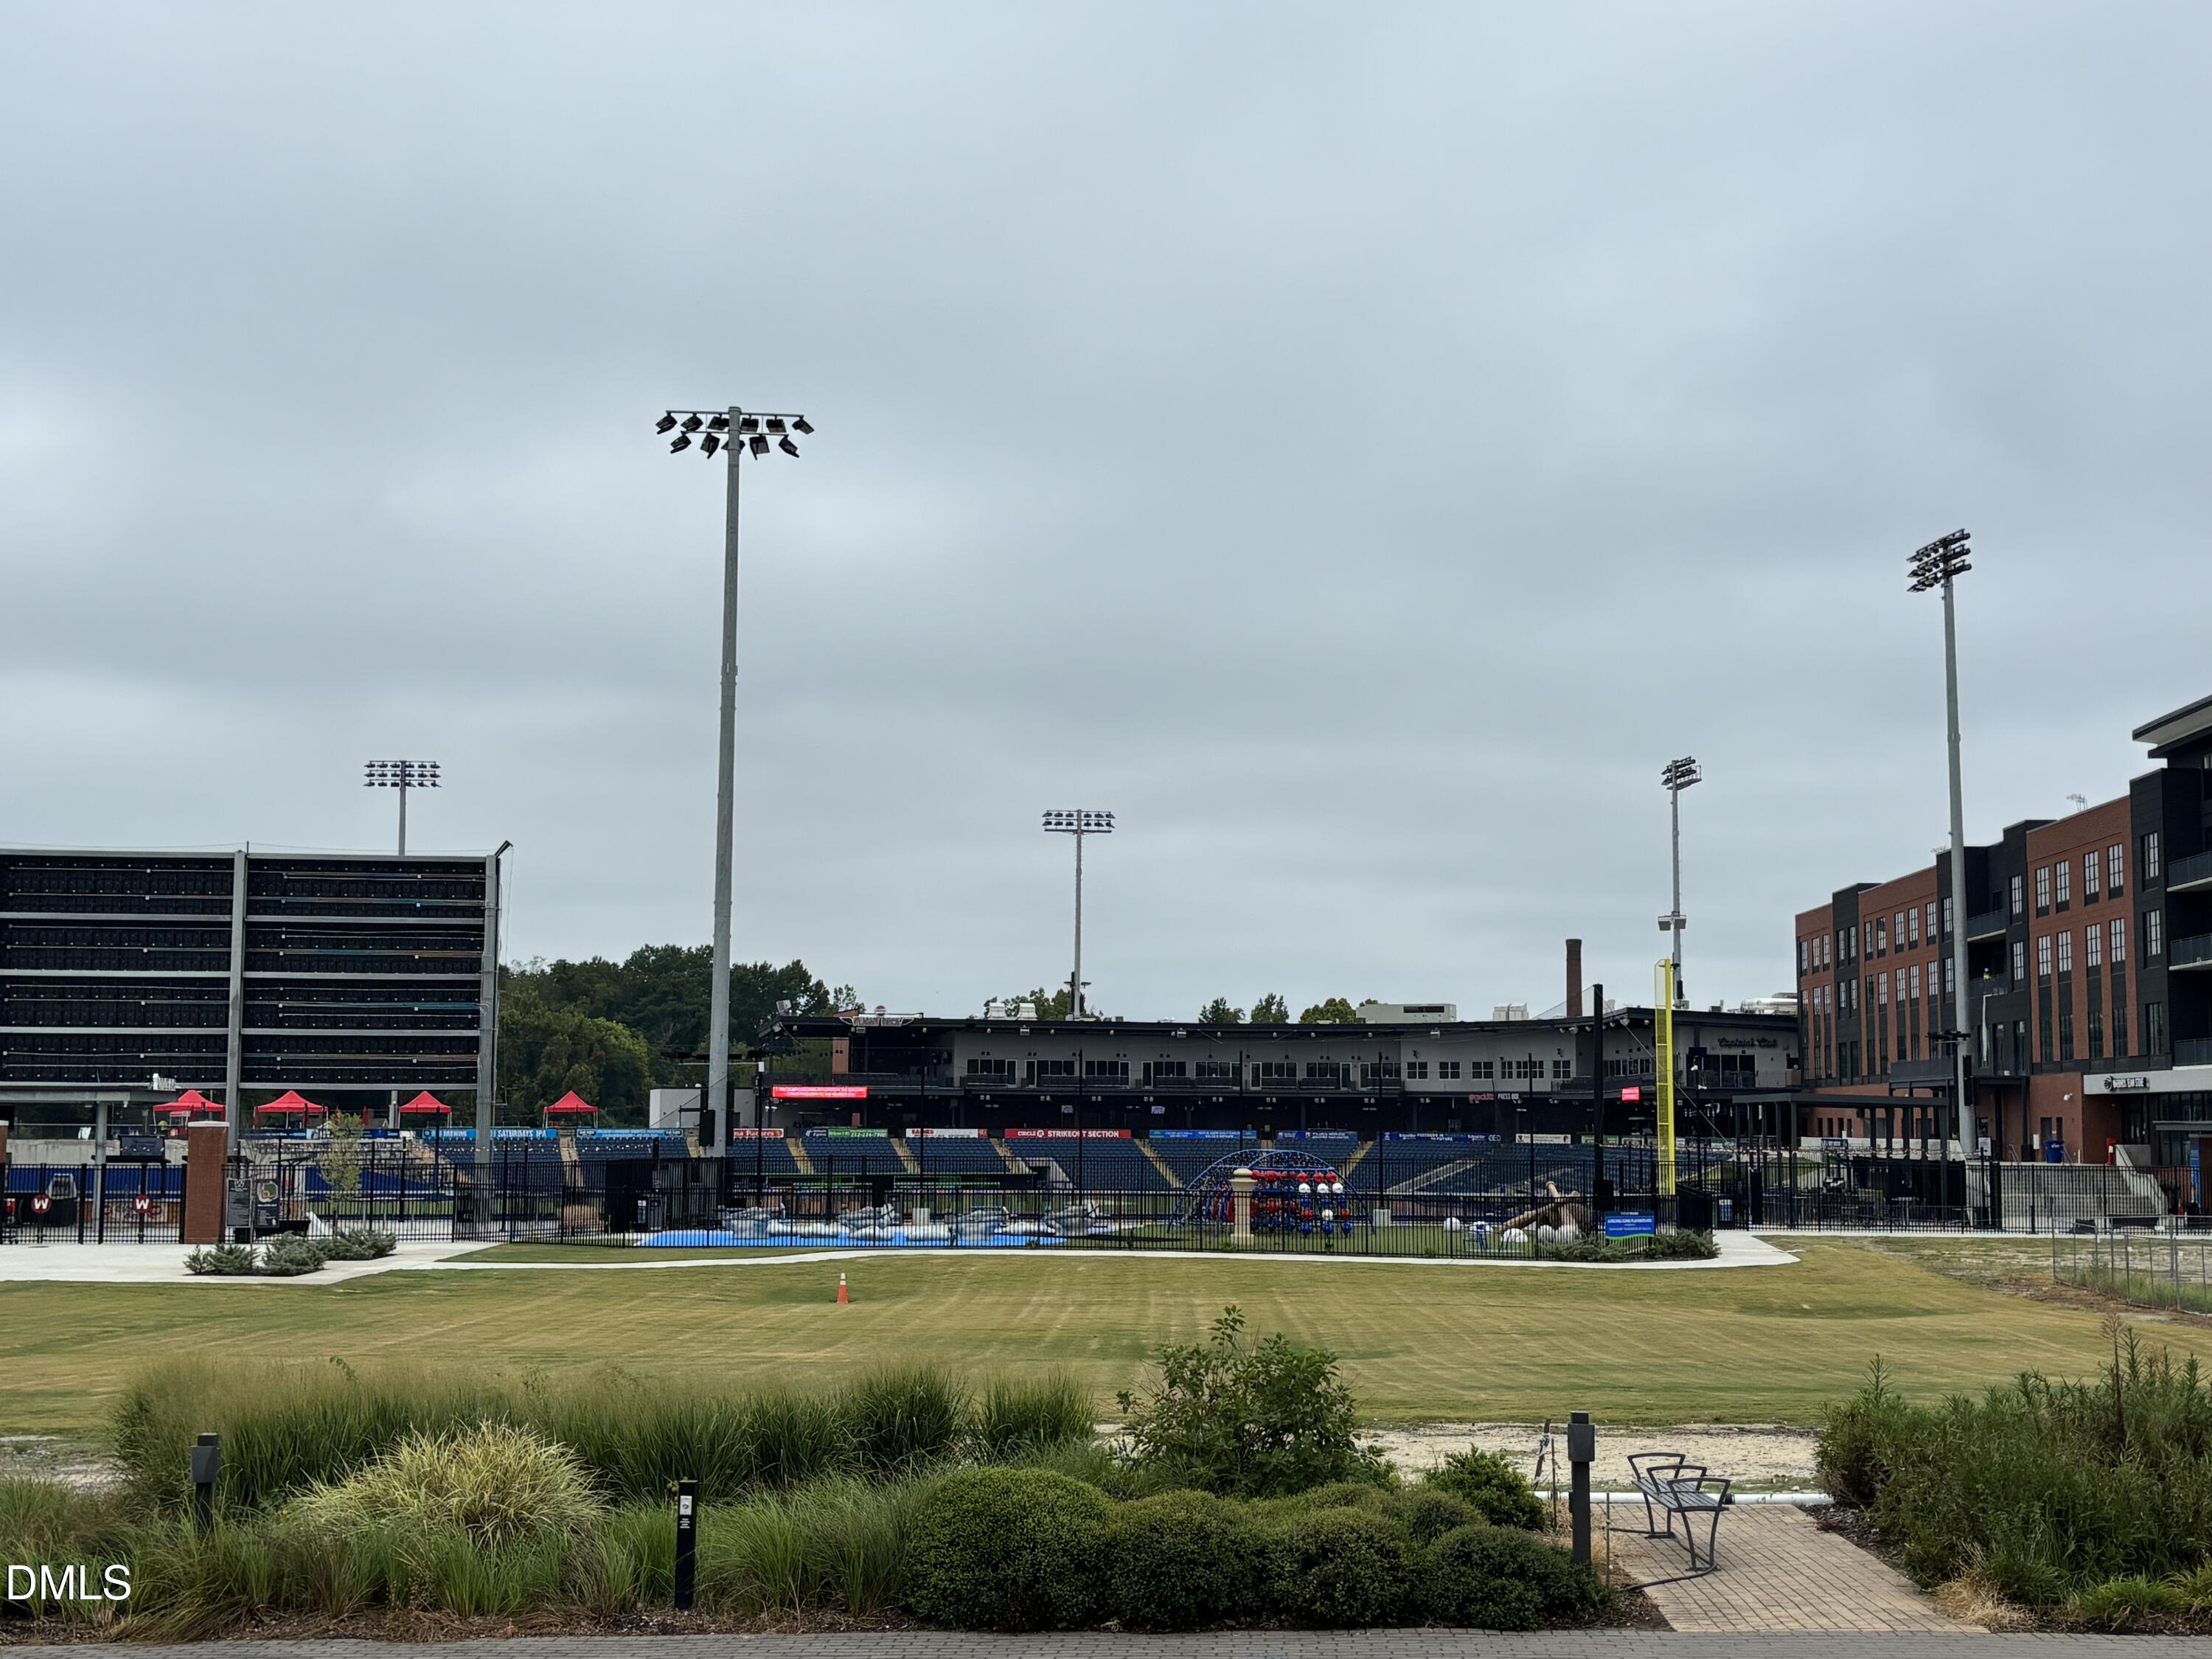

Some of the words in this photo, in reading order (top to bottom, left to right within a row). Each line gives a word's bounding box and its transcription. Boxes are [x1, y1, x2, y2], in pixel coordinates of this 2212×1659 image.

[535, 1130, 547, 1138] IPA
[34, 1198, 49, 1209] W
[136, 1198, 150, 1210] W
